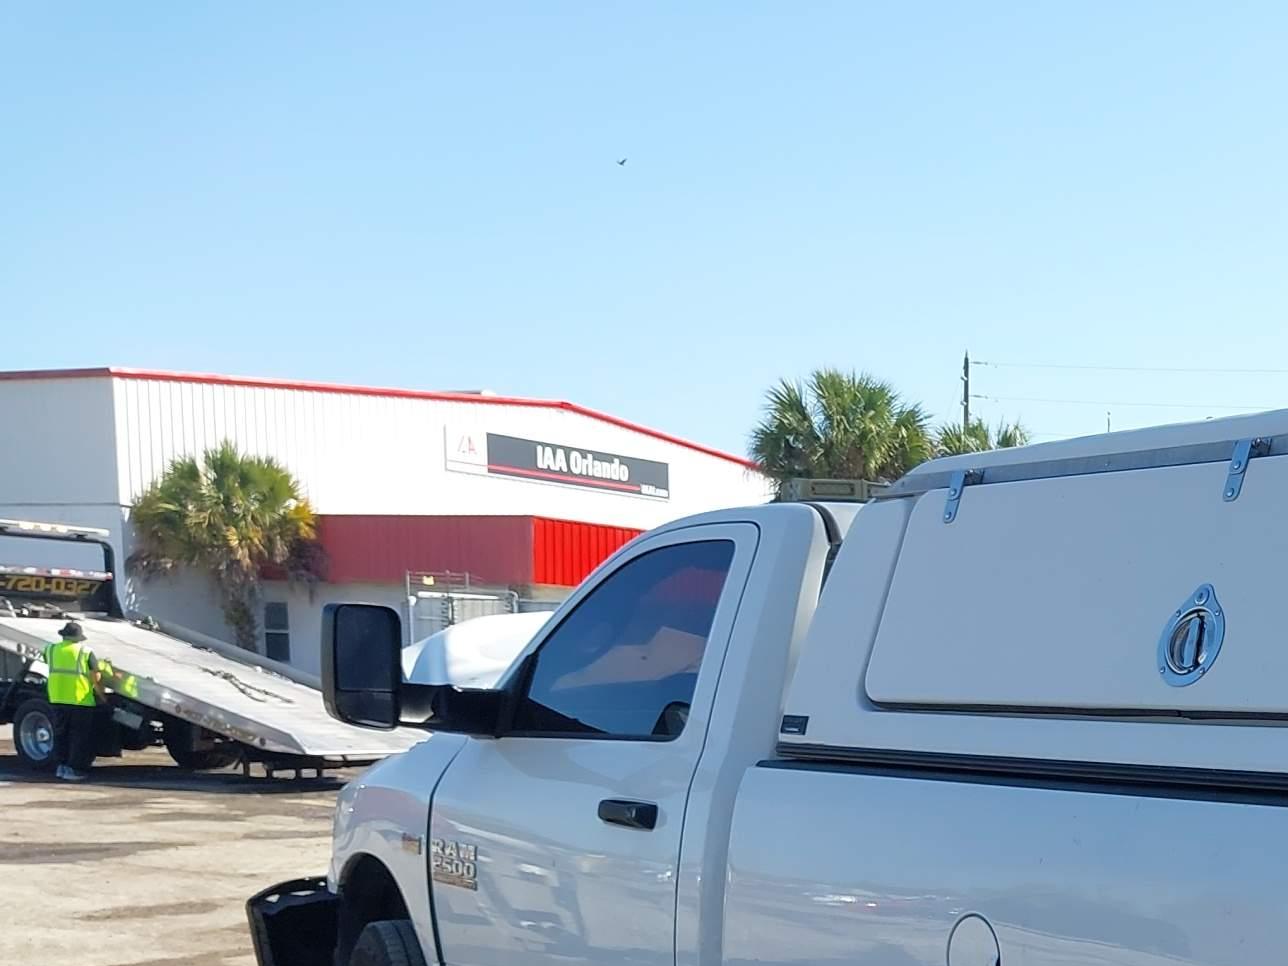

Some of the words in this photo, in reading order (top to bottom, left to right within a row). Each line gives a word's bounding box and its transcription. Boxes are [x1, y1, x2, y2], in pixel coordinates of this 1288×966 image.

[536, 445, 568, 473] IAA
[569, 451, 629, 482] Orlando
[432, 839, 478, 861] RAM
[432, 854, 477, 879] 2500
